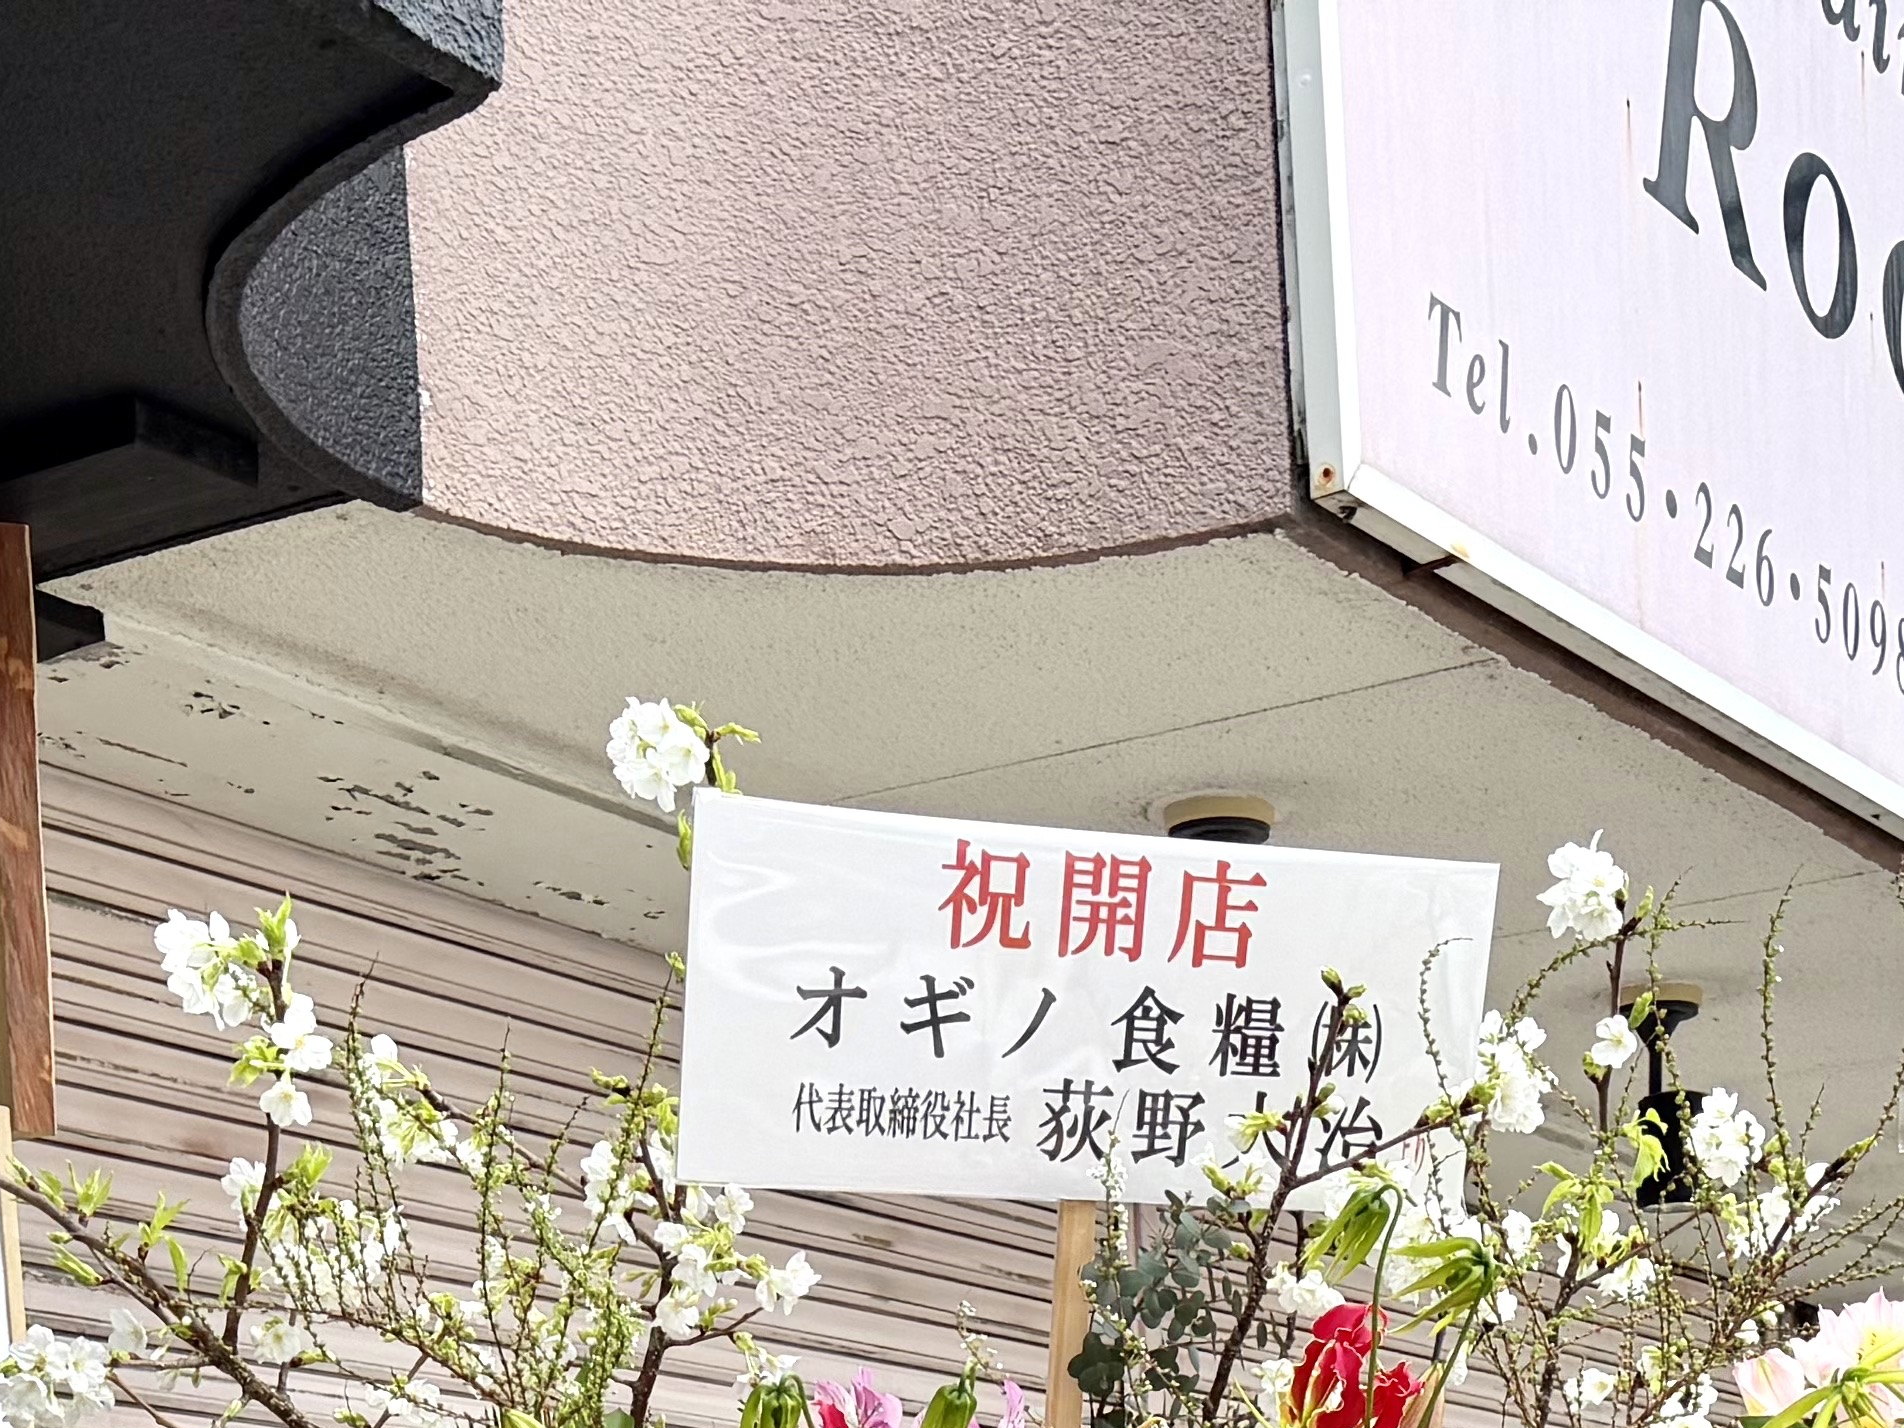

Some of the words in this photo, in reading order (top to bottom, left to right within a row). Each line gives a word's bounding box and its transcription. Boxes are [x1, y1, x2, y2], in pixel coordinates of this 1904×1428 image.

[937, 838, 1268, 970] 祝開店
[791, 1081, 1012, 1147] 代表取締役社長
